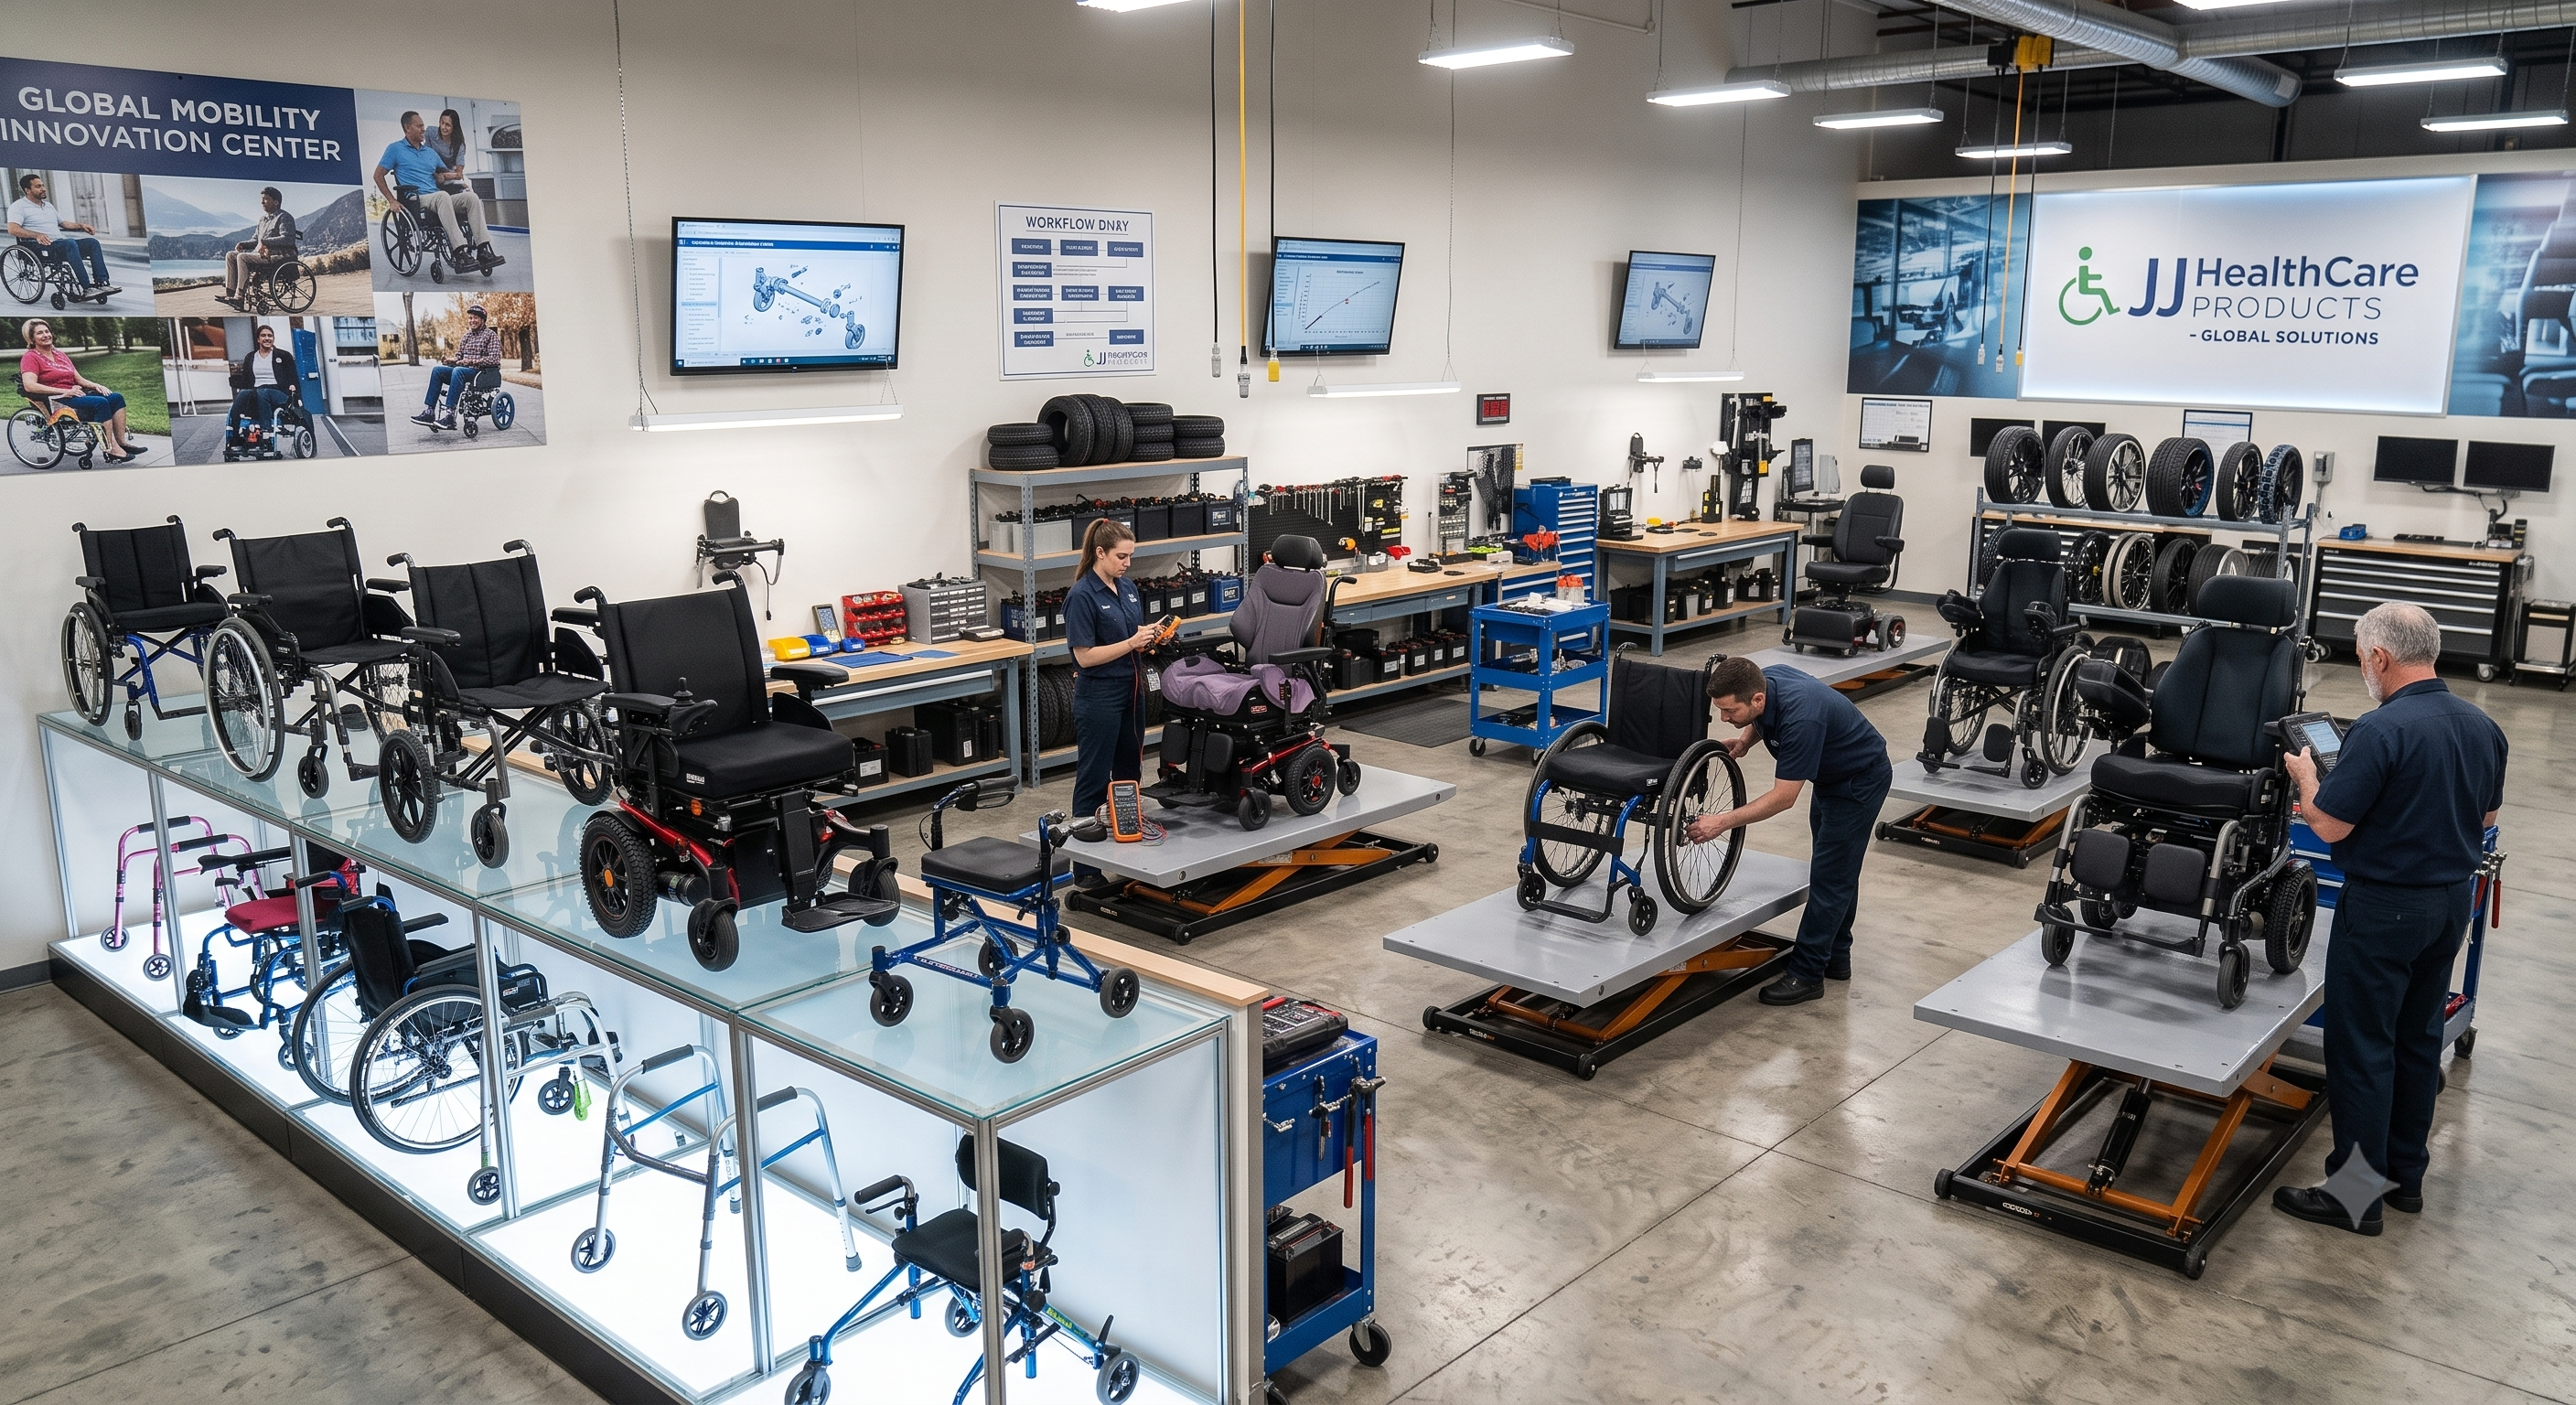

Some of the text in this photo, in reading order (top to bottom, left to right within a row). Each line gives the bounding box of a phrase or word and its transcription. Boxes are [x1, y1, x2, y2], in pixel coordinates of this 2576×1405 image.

[17, 86, 321, 131] GLOBAL MOBILITY
[0, 117, 341, 161] INNOVATION CENTER
[1025, 216, 1096, 231] WORKFLOW
[2127, 255, 2419, 317] JJ HealthCare
[2193, 296, 2381, 320] PRODUCTS
[2201, 329, 2270, 343] GLOBAL
[2275, 330, 2379, 345] SOLUTIONS
